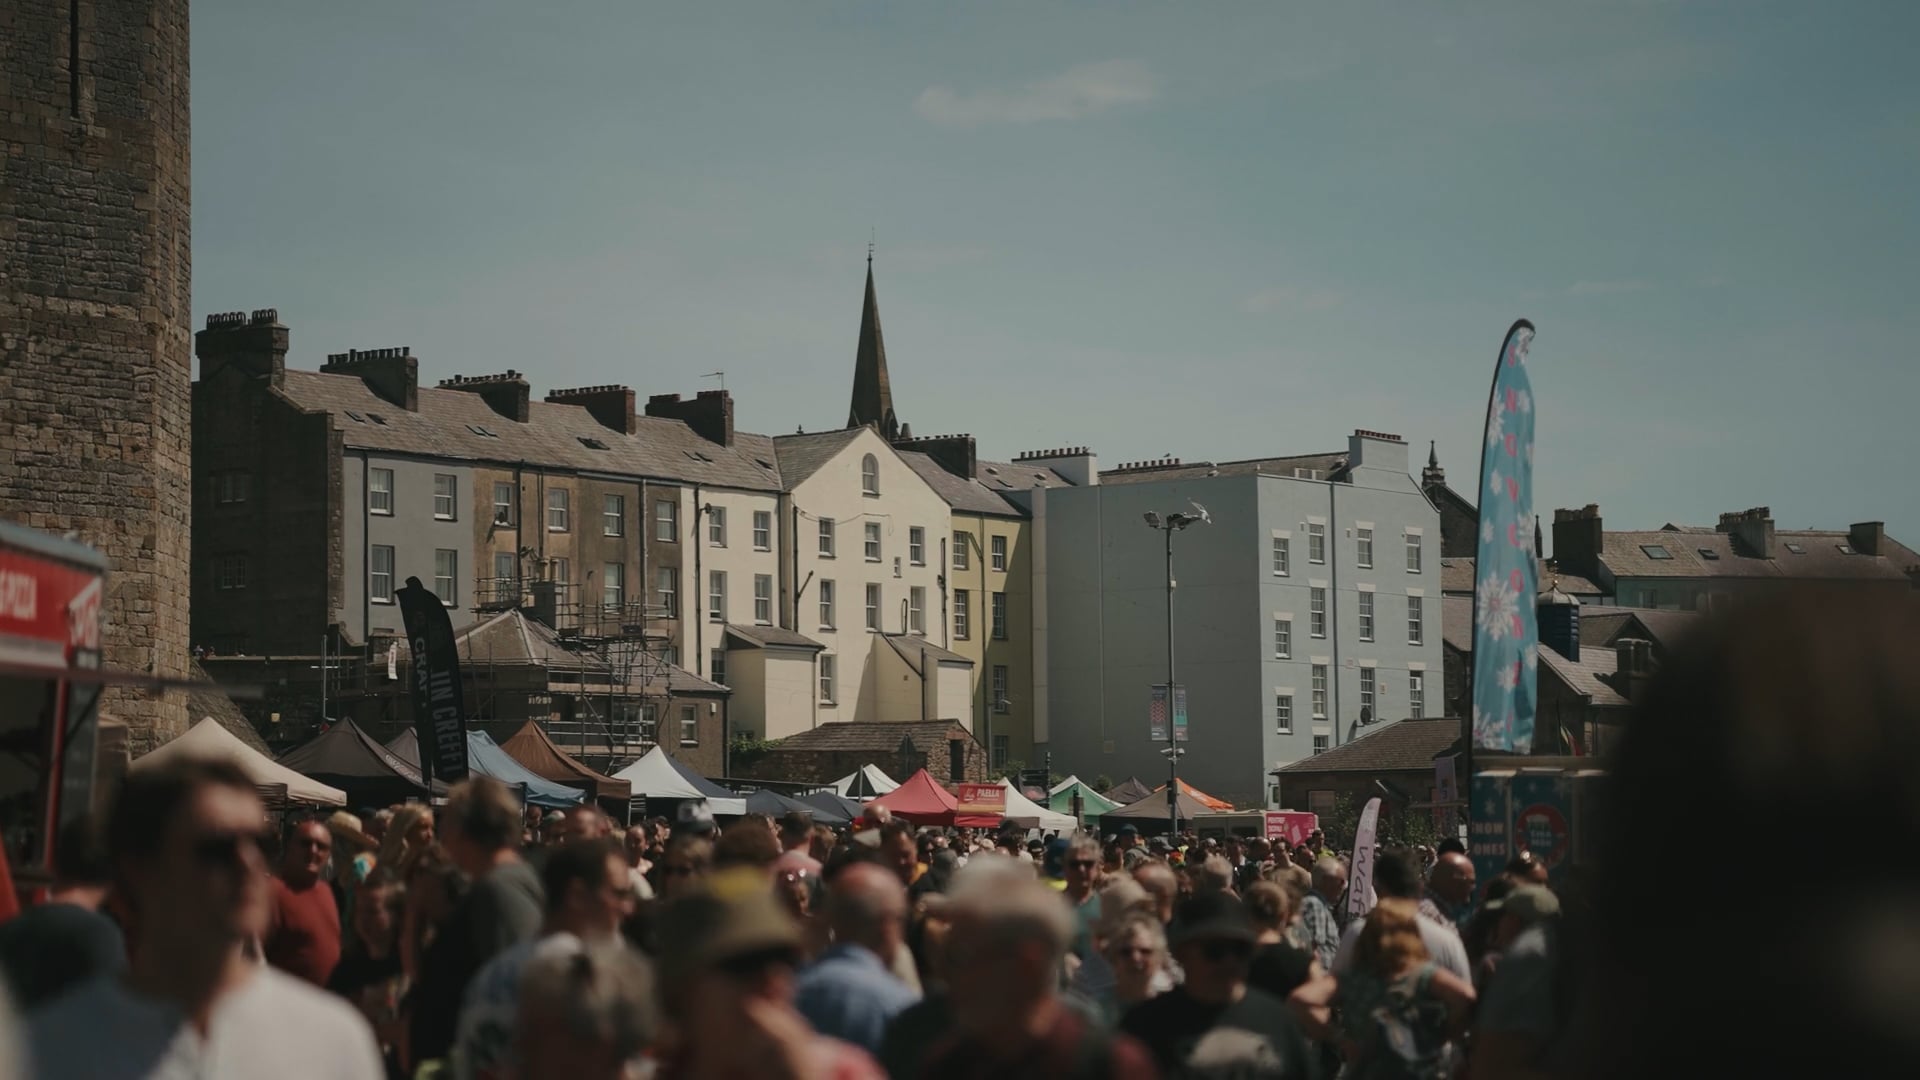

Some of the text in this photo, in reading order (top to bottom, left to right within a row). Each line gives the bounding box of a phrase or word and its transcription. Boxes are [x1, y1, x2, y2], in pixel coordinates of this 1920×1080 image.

[976, 787, 1000, 798] PAELLA
[1471, 822, 1504, 834] NOW
[1471, 843, 1505, 855] ONES
[1352, 846, 1369, 916] waf
